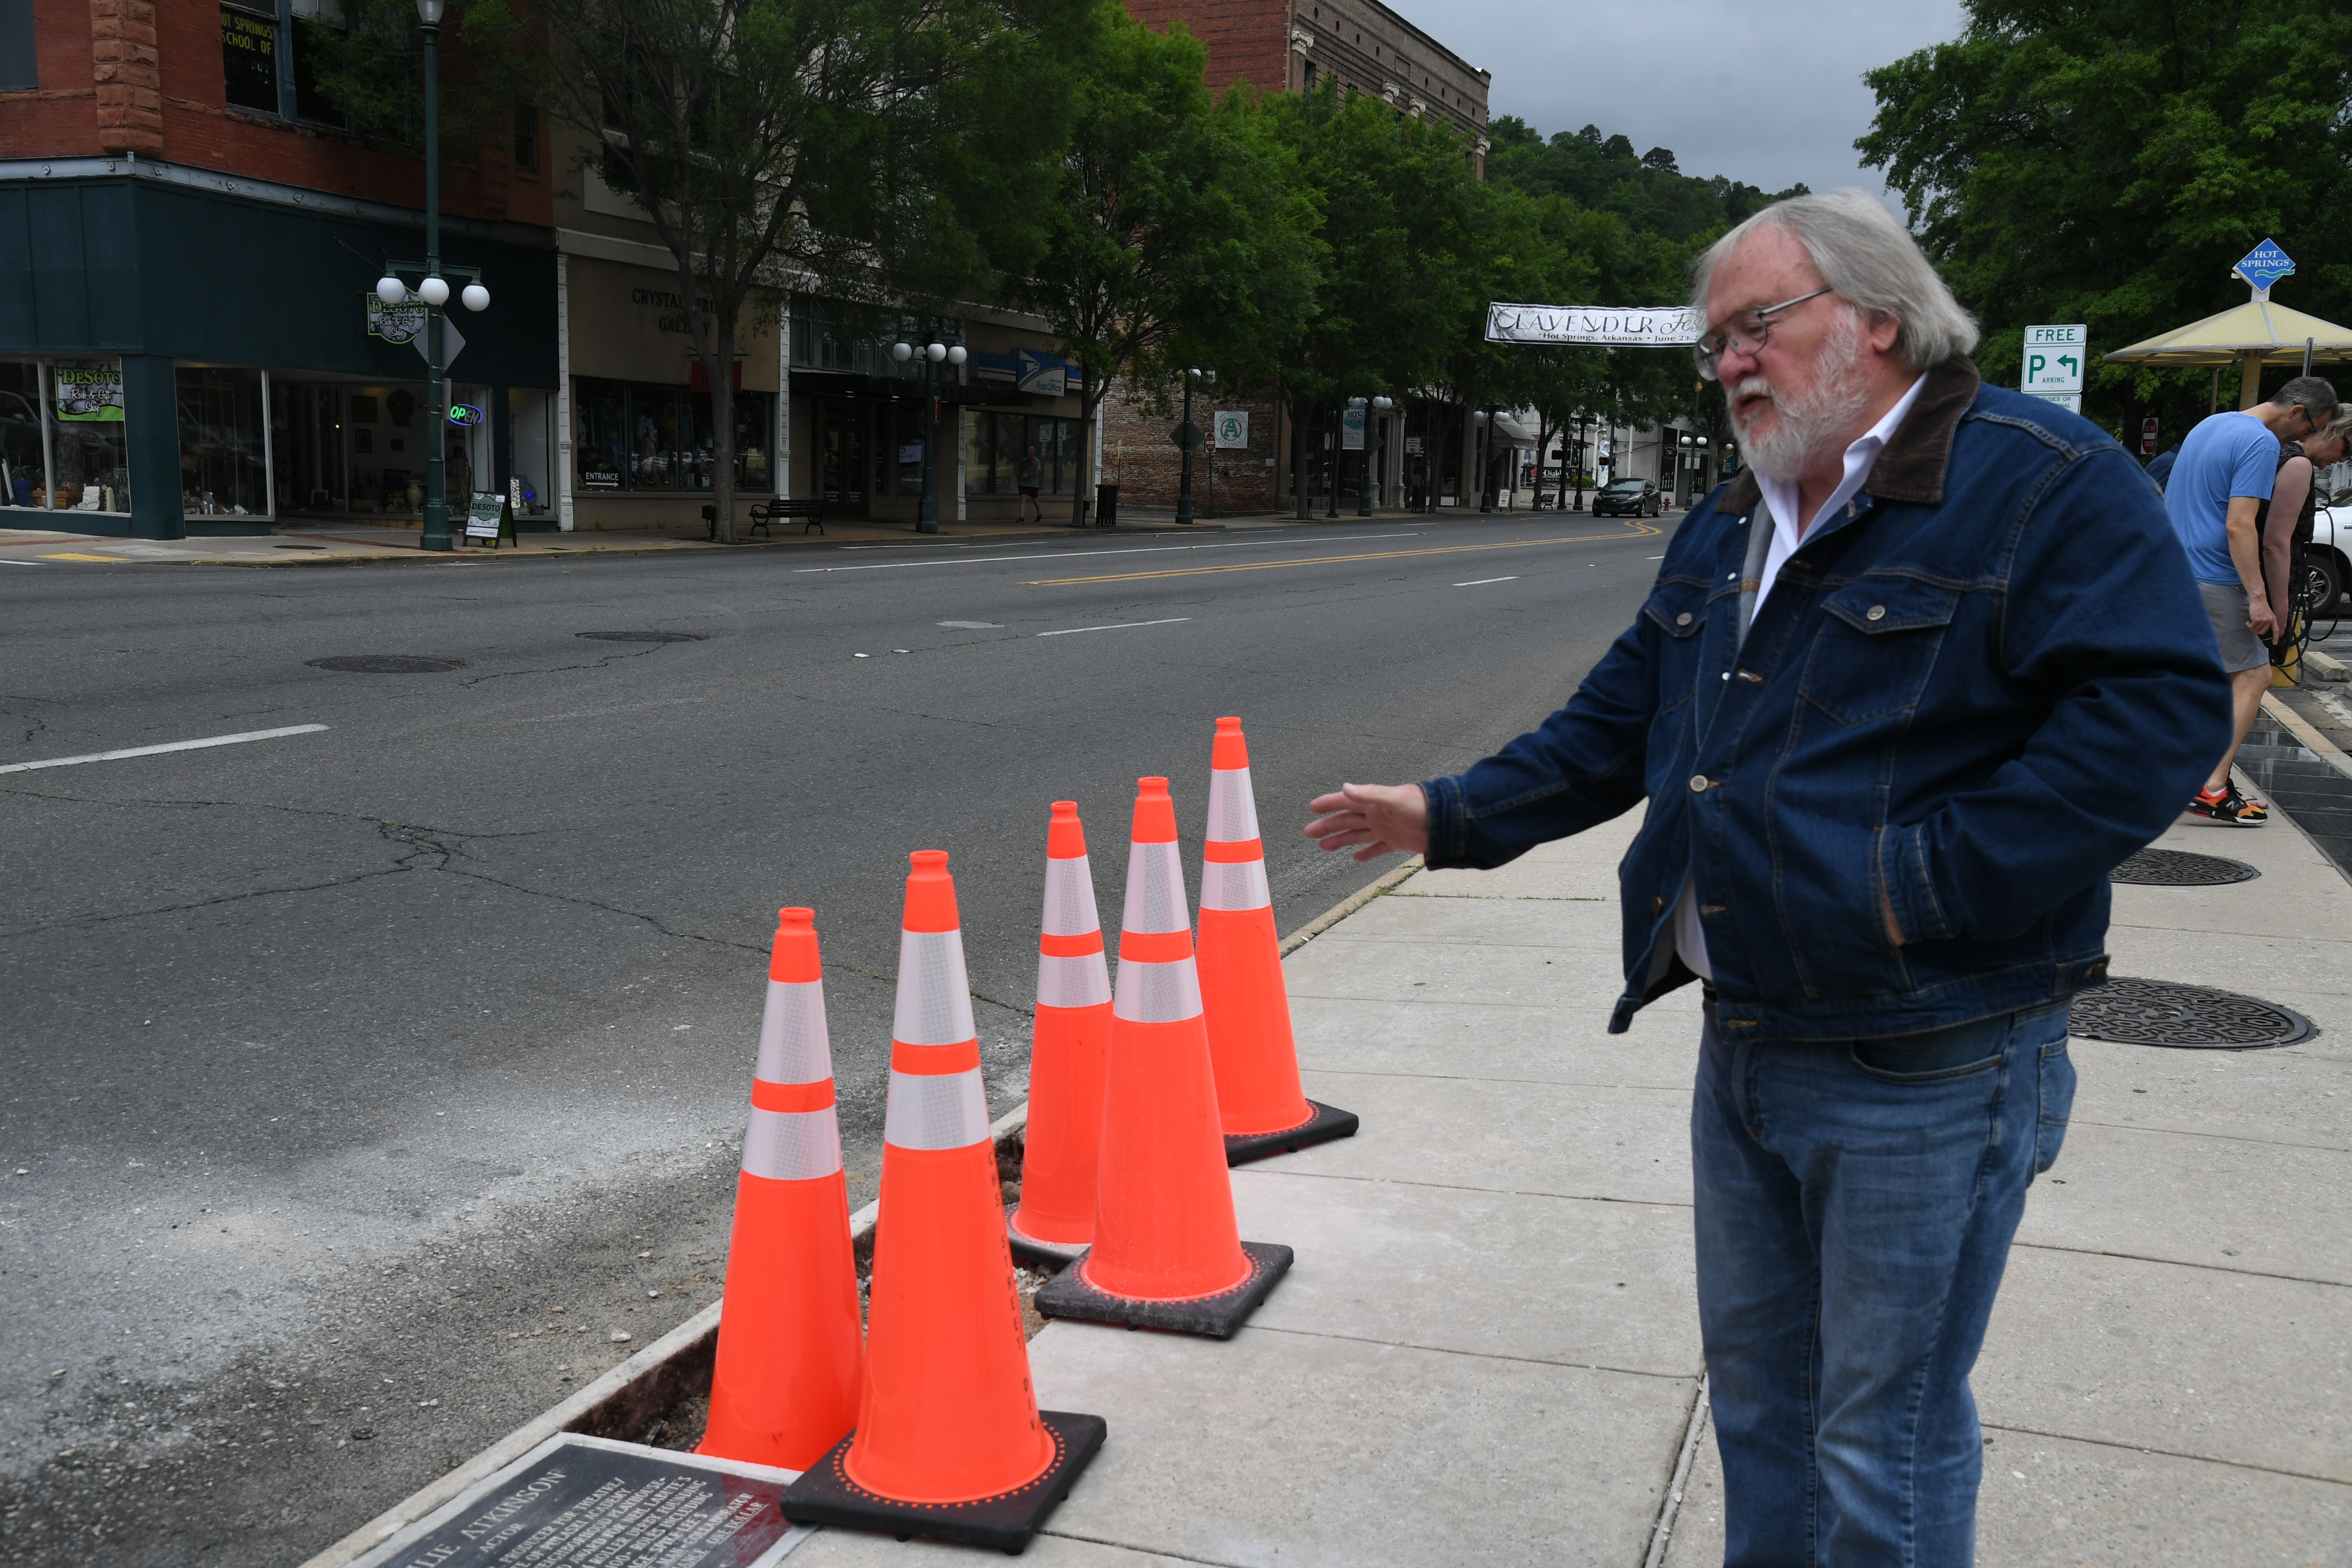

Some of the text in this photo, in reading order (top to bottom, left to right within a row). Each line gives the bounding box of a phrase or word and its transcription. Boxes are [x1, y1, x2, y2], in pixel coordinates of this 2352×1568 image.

[221, 13, 273, 39] OT SPRINGS
[260, 40, 271, 55] OF
[2241, 259, 2289, 268] SPRINGS
[2254, 250, 2279, 259] HOT
[632, 288, 685, 309] CRYSTAL
[402, 317, 415, 329] Gift
[1516, 314, 1653, 333] LAVENDER
[391, 327, 404, 339] Shop
[2035, 328, 2075, 341] FREE
[2029, 355, 2046, 384] P
[1036, 381, 1061, 392] Post Office
[88, 389, 96, 399] &
[98, 389, 113, 404] Gift
[85, 402, 100, 416] Shop
[451, 406, 480, 425] OPEN
[1228, 413, 1244, 424] THINGS
[1222, 418, 1240, 437] A
[1218, 438, 1242, 447] ARKANSAS
[586, 472, 619, 481] ENTRANCE
[471, 503, 500, 512] DESOTO
[1001, 1235, 1021, 1349] STREET
[404, 1471, 568, 1567] LIE ATKINSON
[523, 1549, 545, 1561] OF
[538, 1520, 589, 1550] PULASKI
[583, 1487, 635, 1520] ACADEMY.
[569, 1537, 608, 1563] AWARD
[601, 1523, 629, 1538] FOR
[621, 1507, 652, 1522] NEIL
[643, 1475, 693, 1507] LABUTE'S
[587, 1480, 709, 1565] ROLLER DERBY FOUNDING
[629, 1527, 668, 1551] ROLES
[658, 1491, 715, 1528] INCLUDING
[681, 1493, 755, 1544] COLLABORATOR
[705, 1529, 732, 1544] ONE
[723, 1502, 766, 1529] DOLLAR
[480, 1523, 526, 1553] ACTOR
[498, 1526, 559, 1563] PRODUCER
[551, 1511, 579, 1526] FOR
[648, 1531, 684, 1552] SPIKE
[675, 1512, 710, 1532] LEE'S
